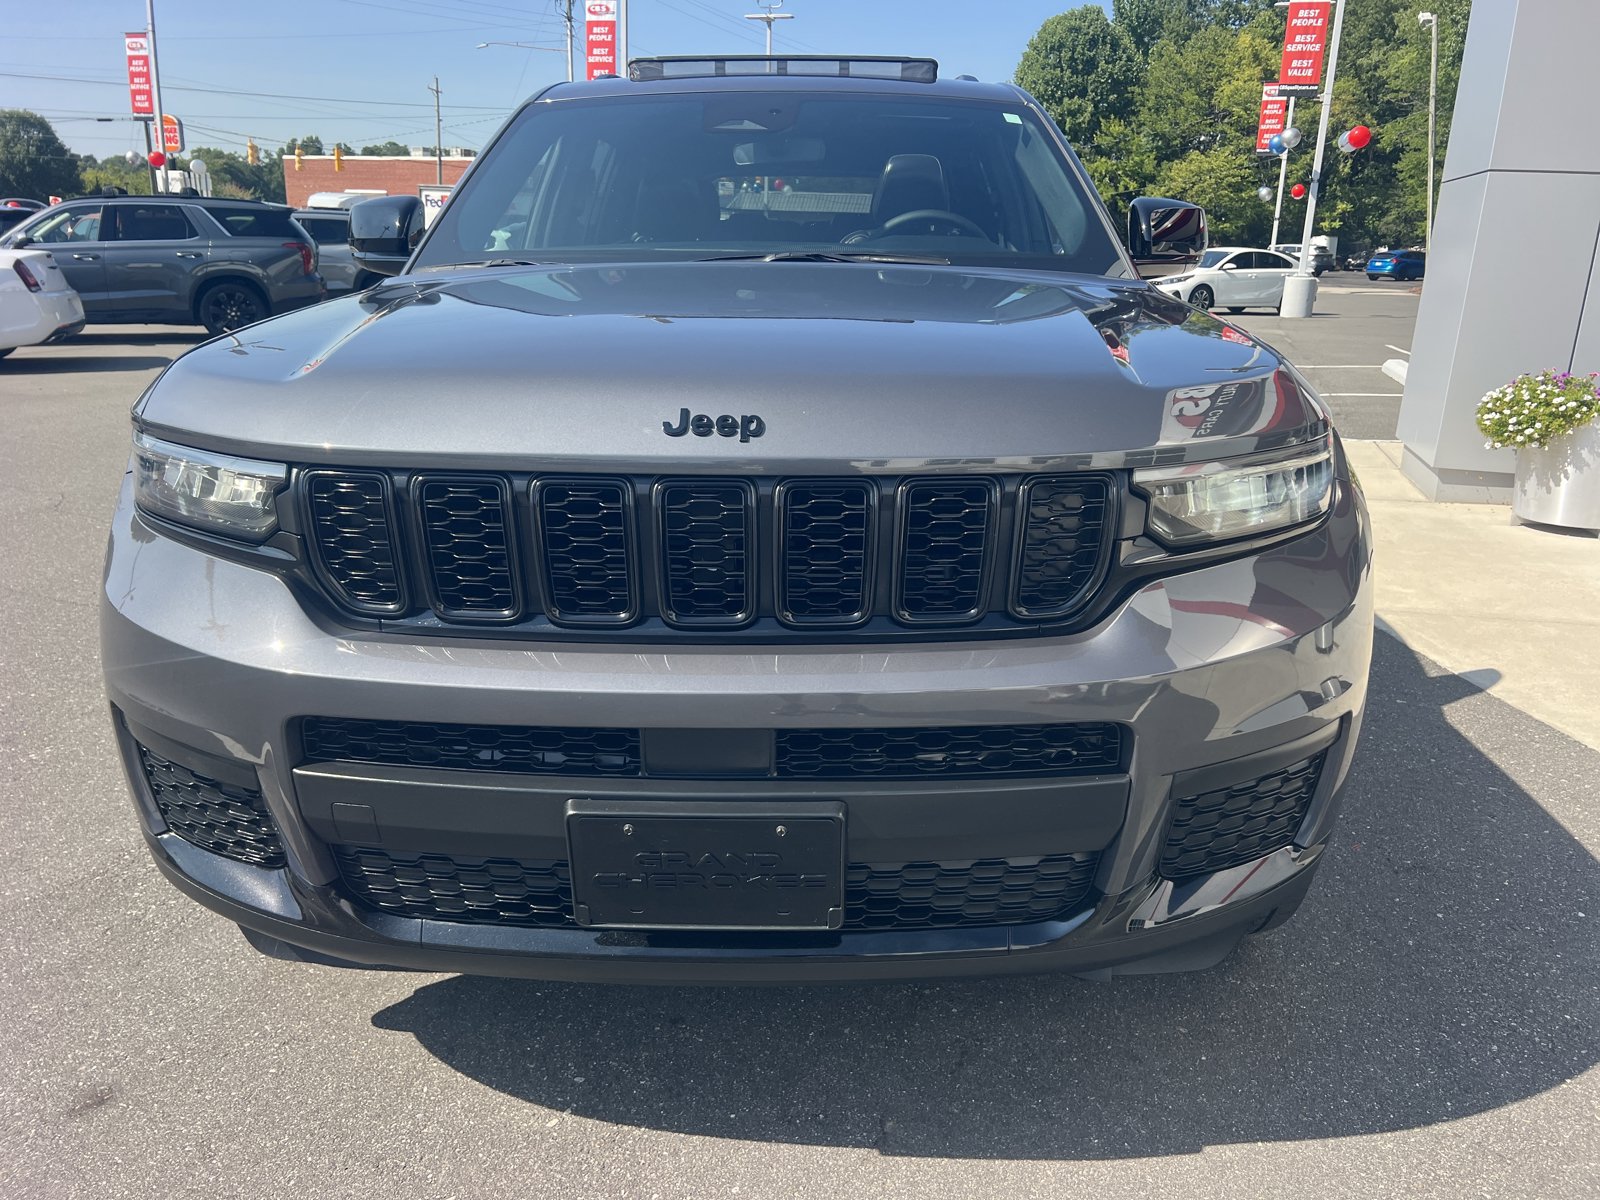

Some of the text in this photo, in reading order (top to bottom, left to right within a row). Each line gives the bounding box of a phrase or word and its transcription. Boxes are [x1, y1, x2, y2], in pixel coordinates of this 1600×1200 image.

[1298, 9, 1321, 17] BEST
[1291, 18, 1324, 27] PEOPLE
[1294, 34, 1317, 43] BEST
[1285, 43, 1321, 52] SERVICE
[1291, 59, 1313, 68] BEST
[1287, 68, 1314, 77] VALUE
[662, 408, 767, 443] Jeep
[633, 852, 783, 869] GRAND
[592, 872, 828, 890] CHEROKEE
